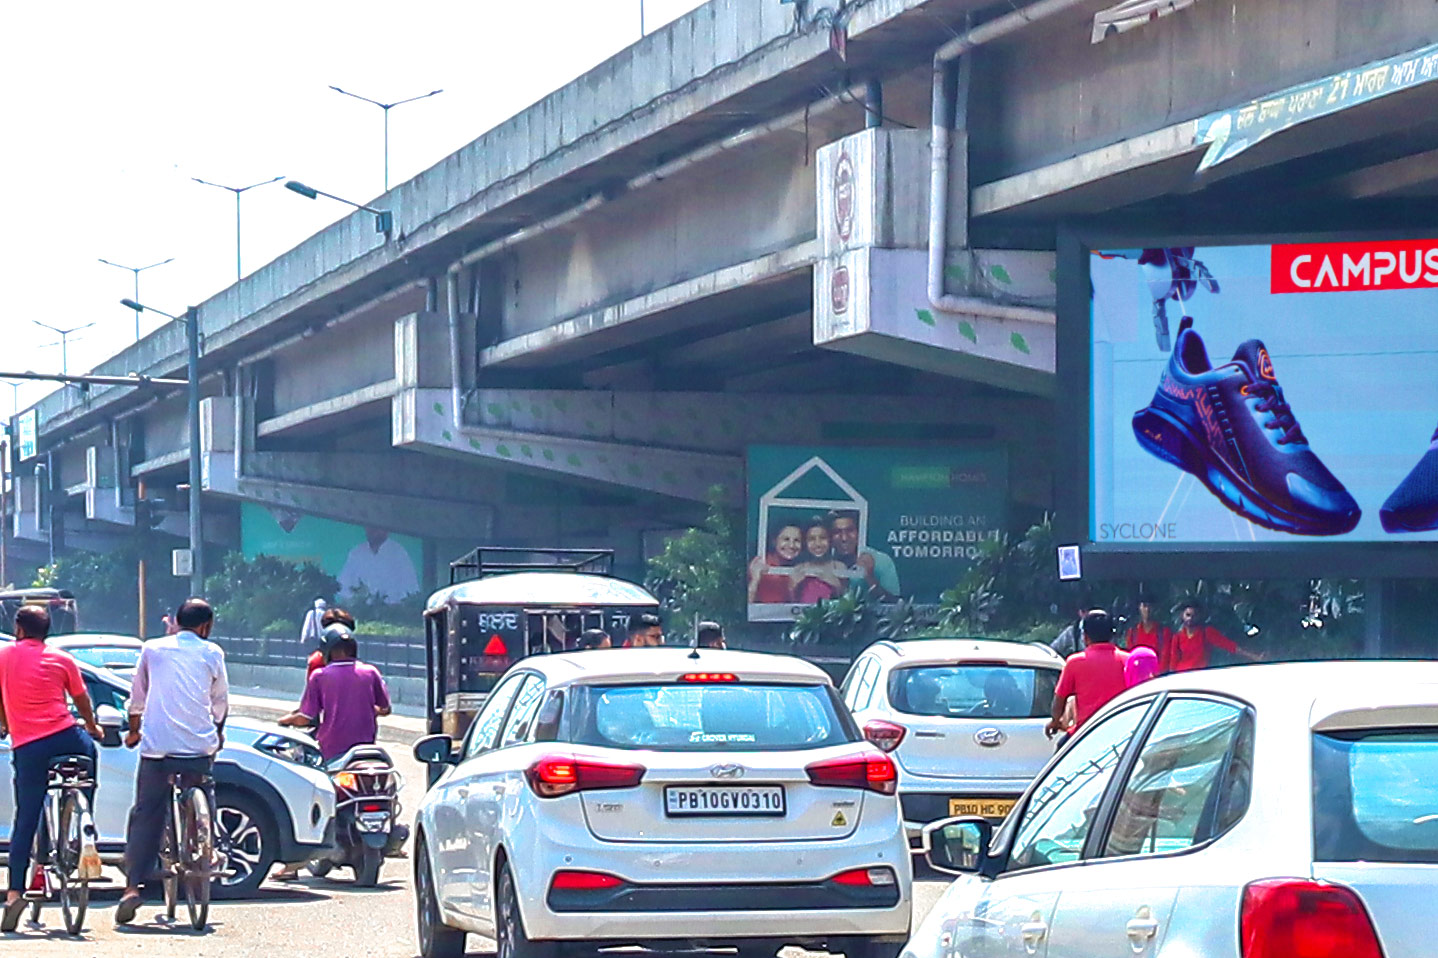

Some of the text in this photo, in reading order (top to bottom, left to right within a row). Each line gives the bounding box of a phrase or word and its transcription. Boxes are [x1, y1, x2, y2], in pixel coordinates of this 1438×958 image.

[900, 515, 963, 526] BUILDING
[1099, 522, 1177, 540] SYCLONE
[678, 791, 781, 810] PB10GV0310
